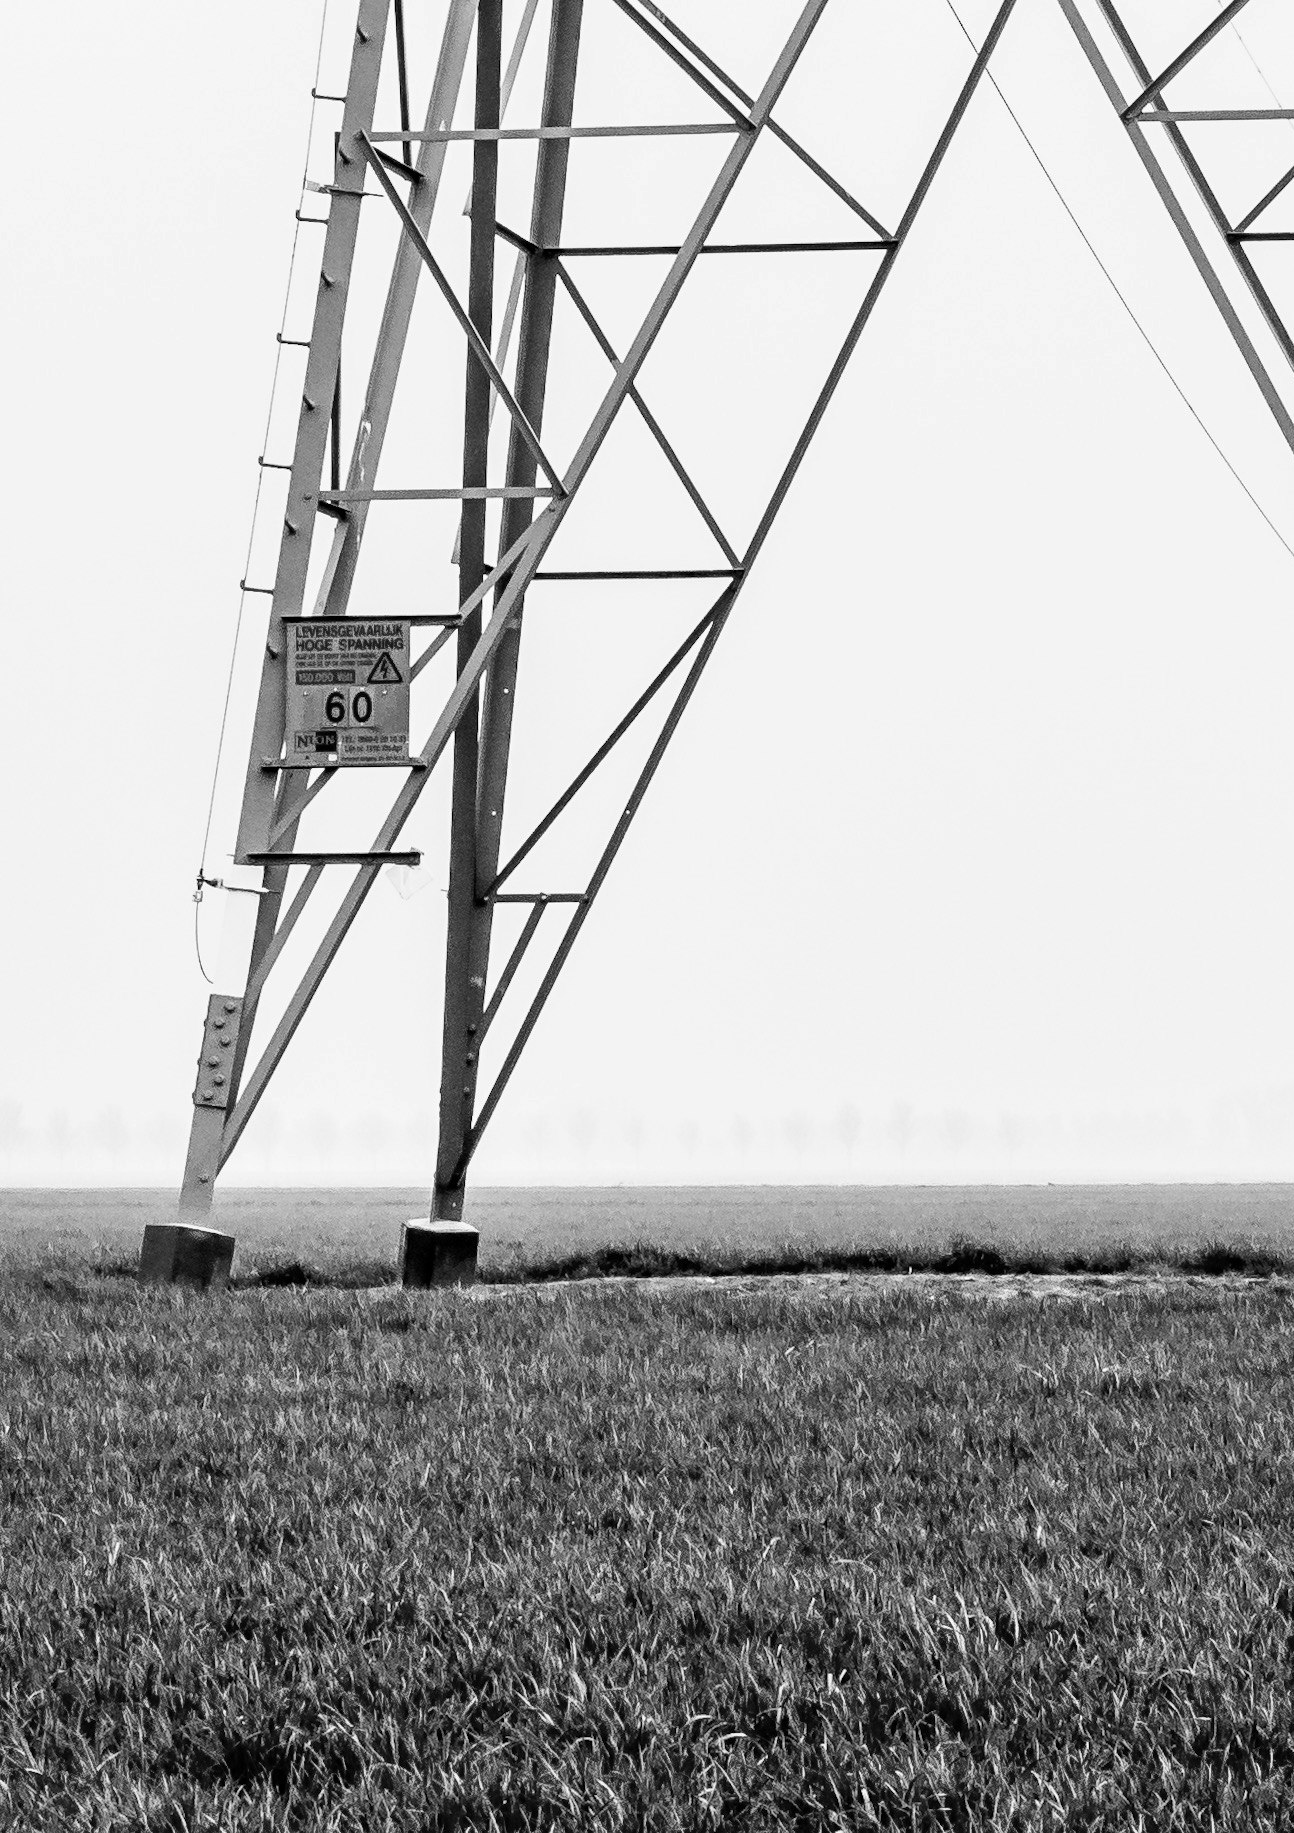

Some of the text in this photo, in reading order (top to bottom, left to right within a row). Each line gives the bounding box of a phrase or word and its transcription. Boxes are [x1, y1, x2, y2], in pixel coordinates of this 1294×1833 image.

[296, 625, 402, 638] LEVENSGEVAARLIJK
[296, 638, 404, 651] HOGE SPANNING
[325, 691, 373, 723] 60
